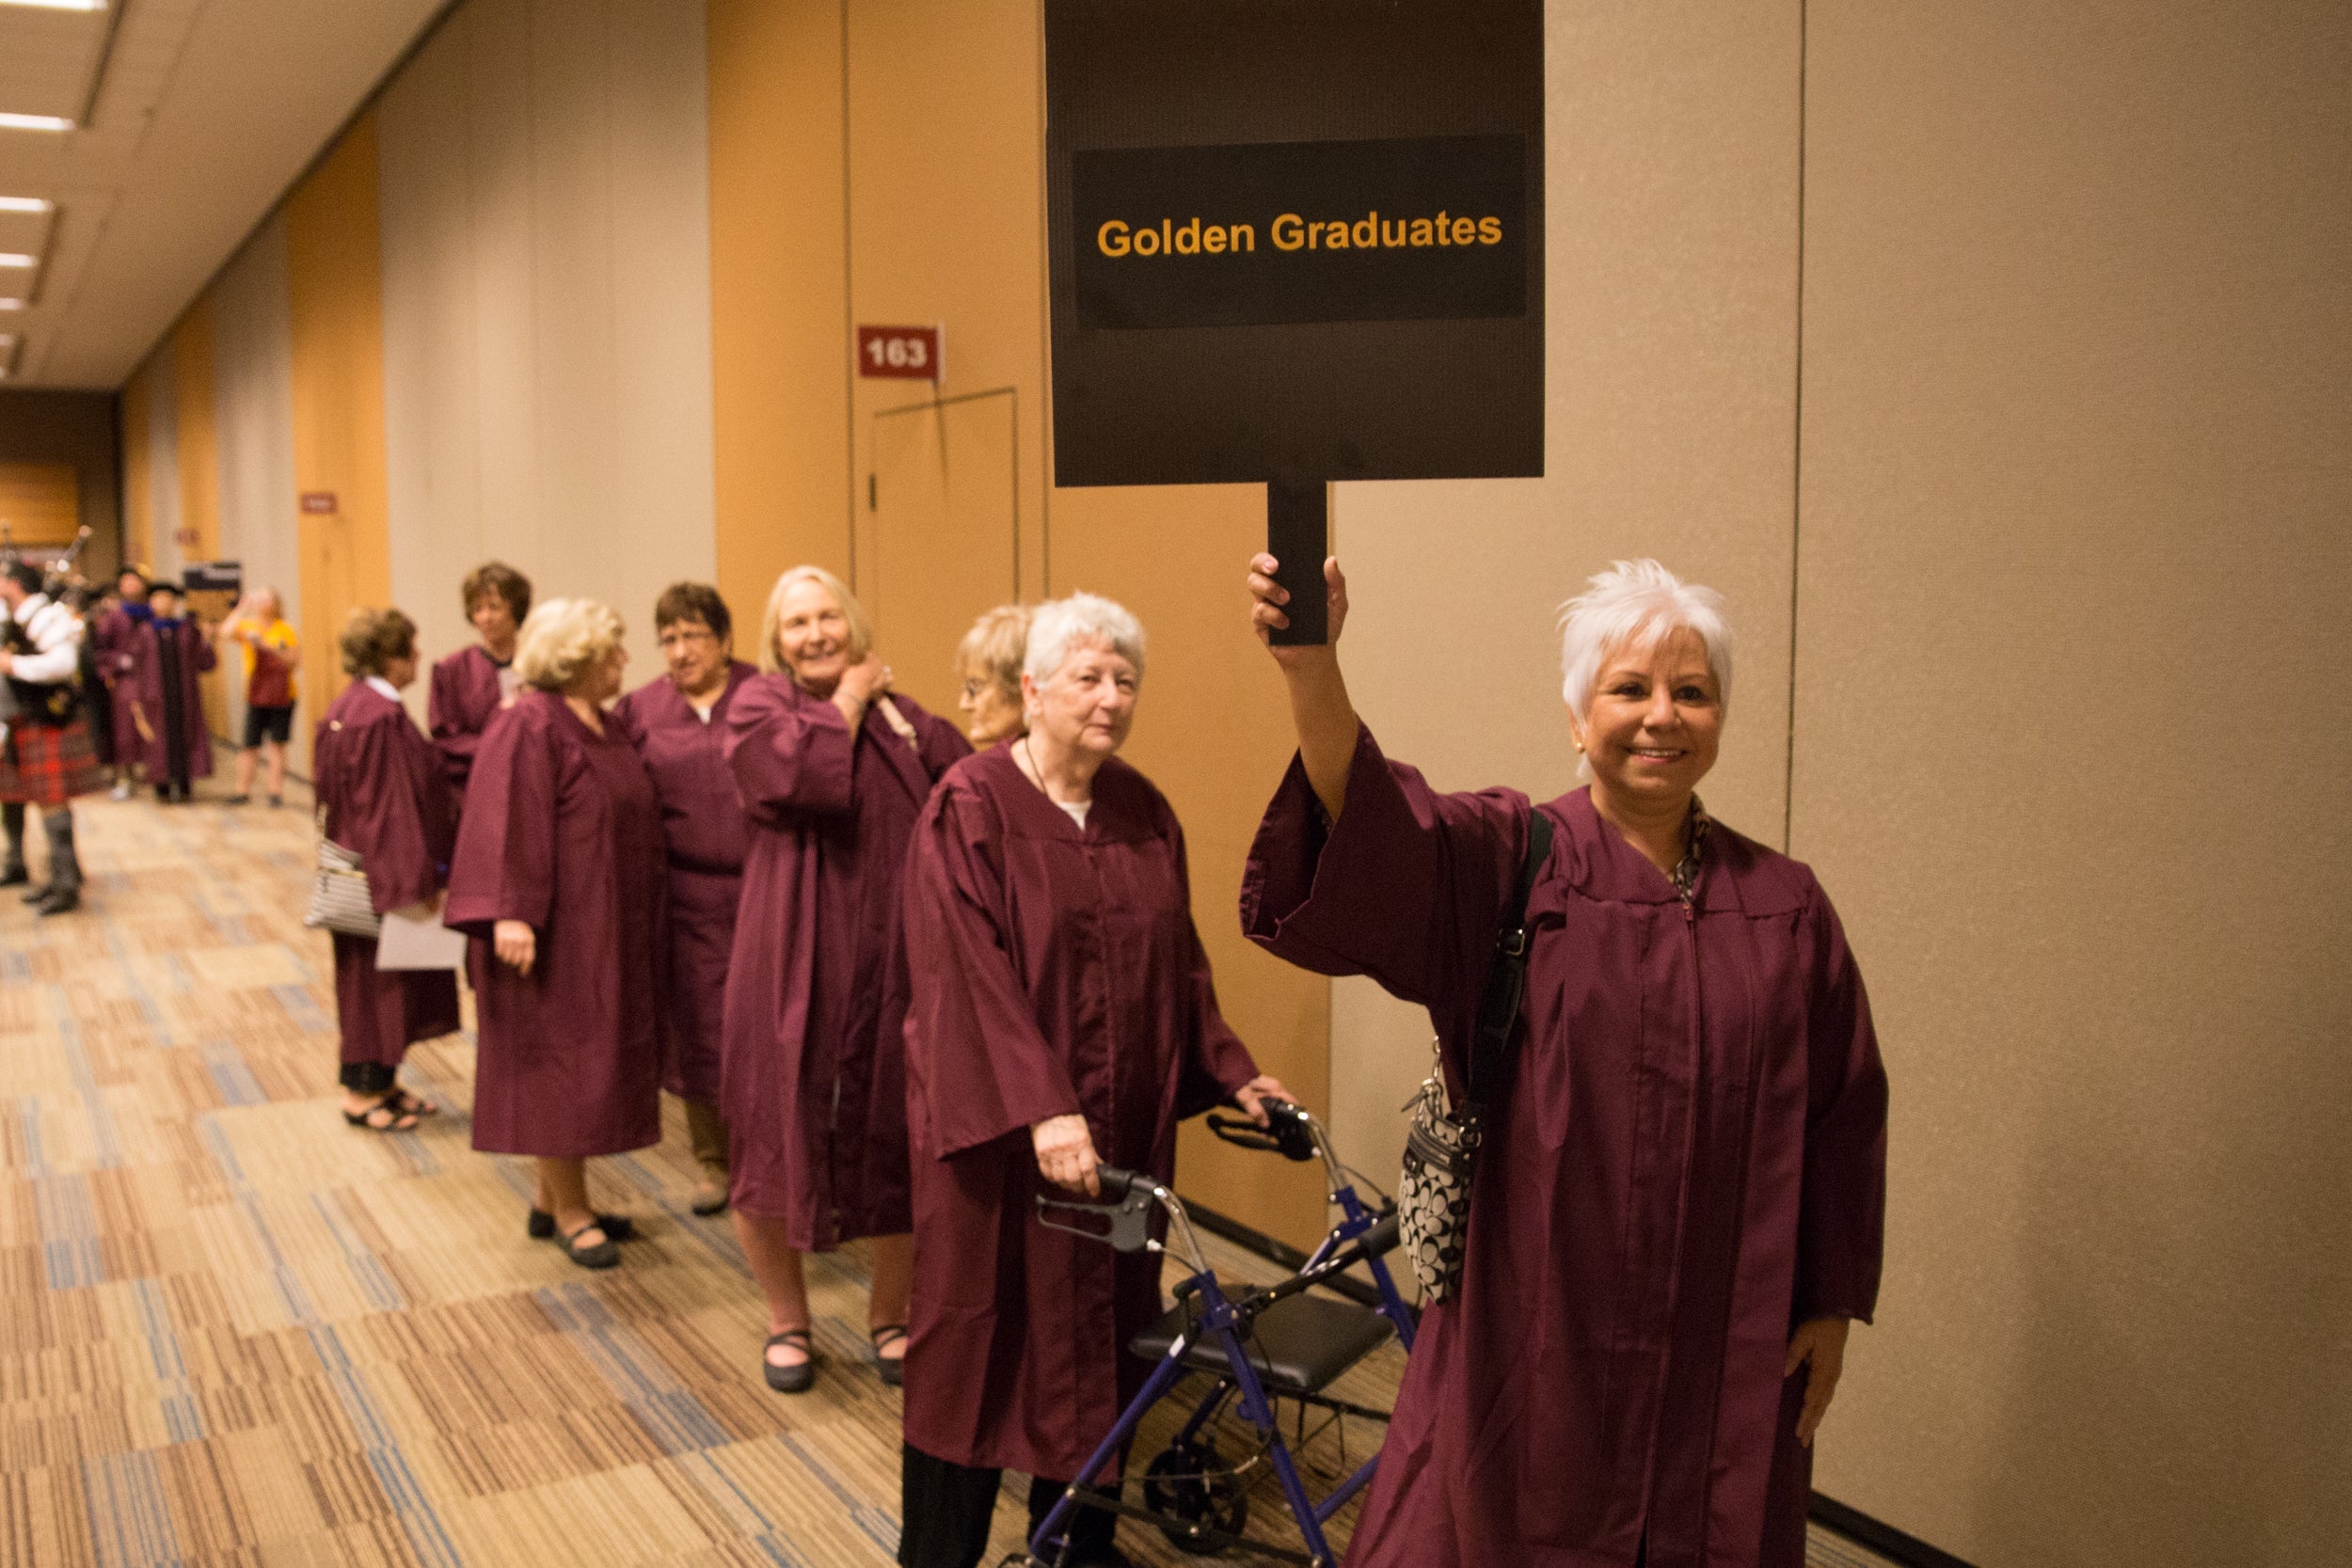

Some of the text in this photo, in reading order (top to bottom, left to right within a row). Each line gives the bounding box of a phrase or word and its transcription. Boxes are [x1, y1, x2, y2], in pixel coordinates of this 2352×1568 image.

[1097, 210, 1502, 258] Golden Graduates
[866, 338, 928, 368] 163
